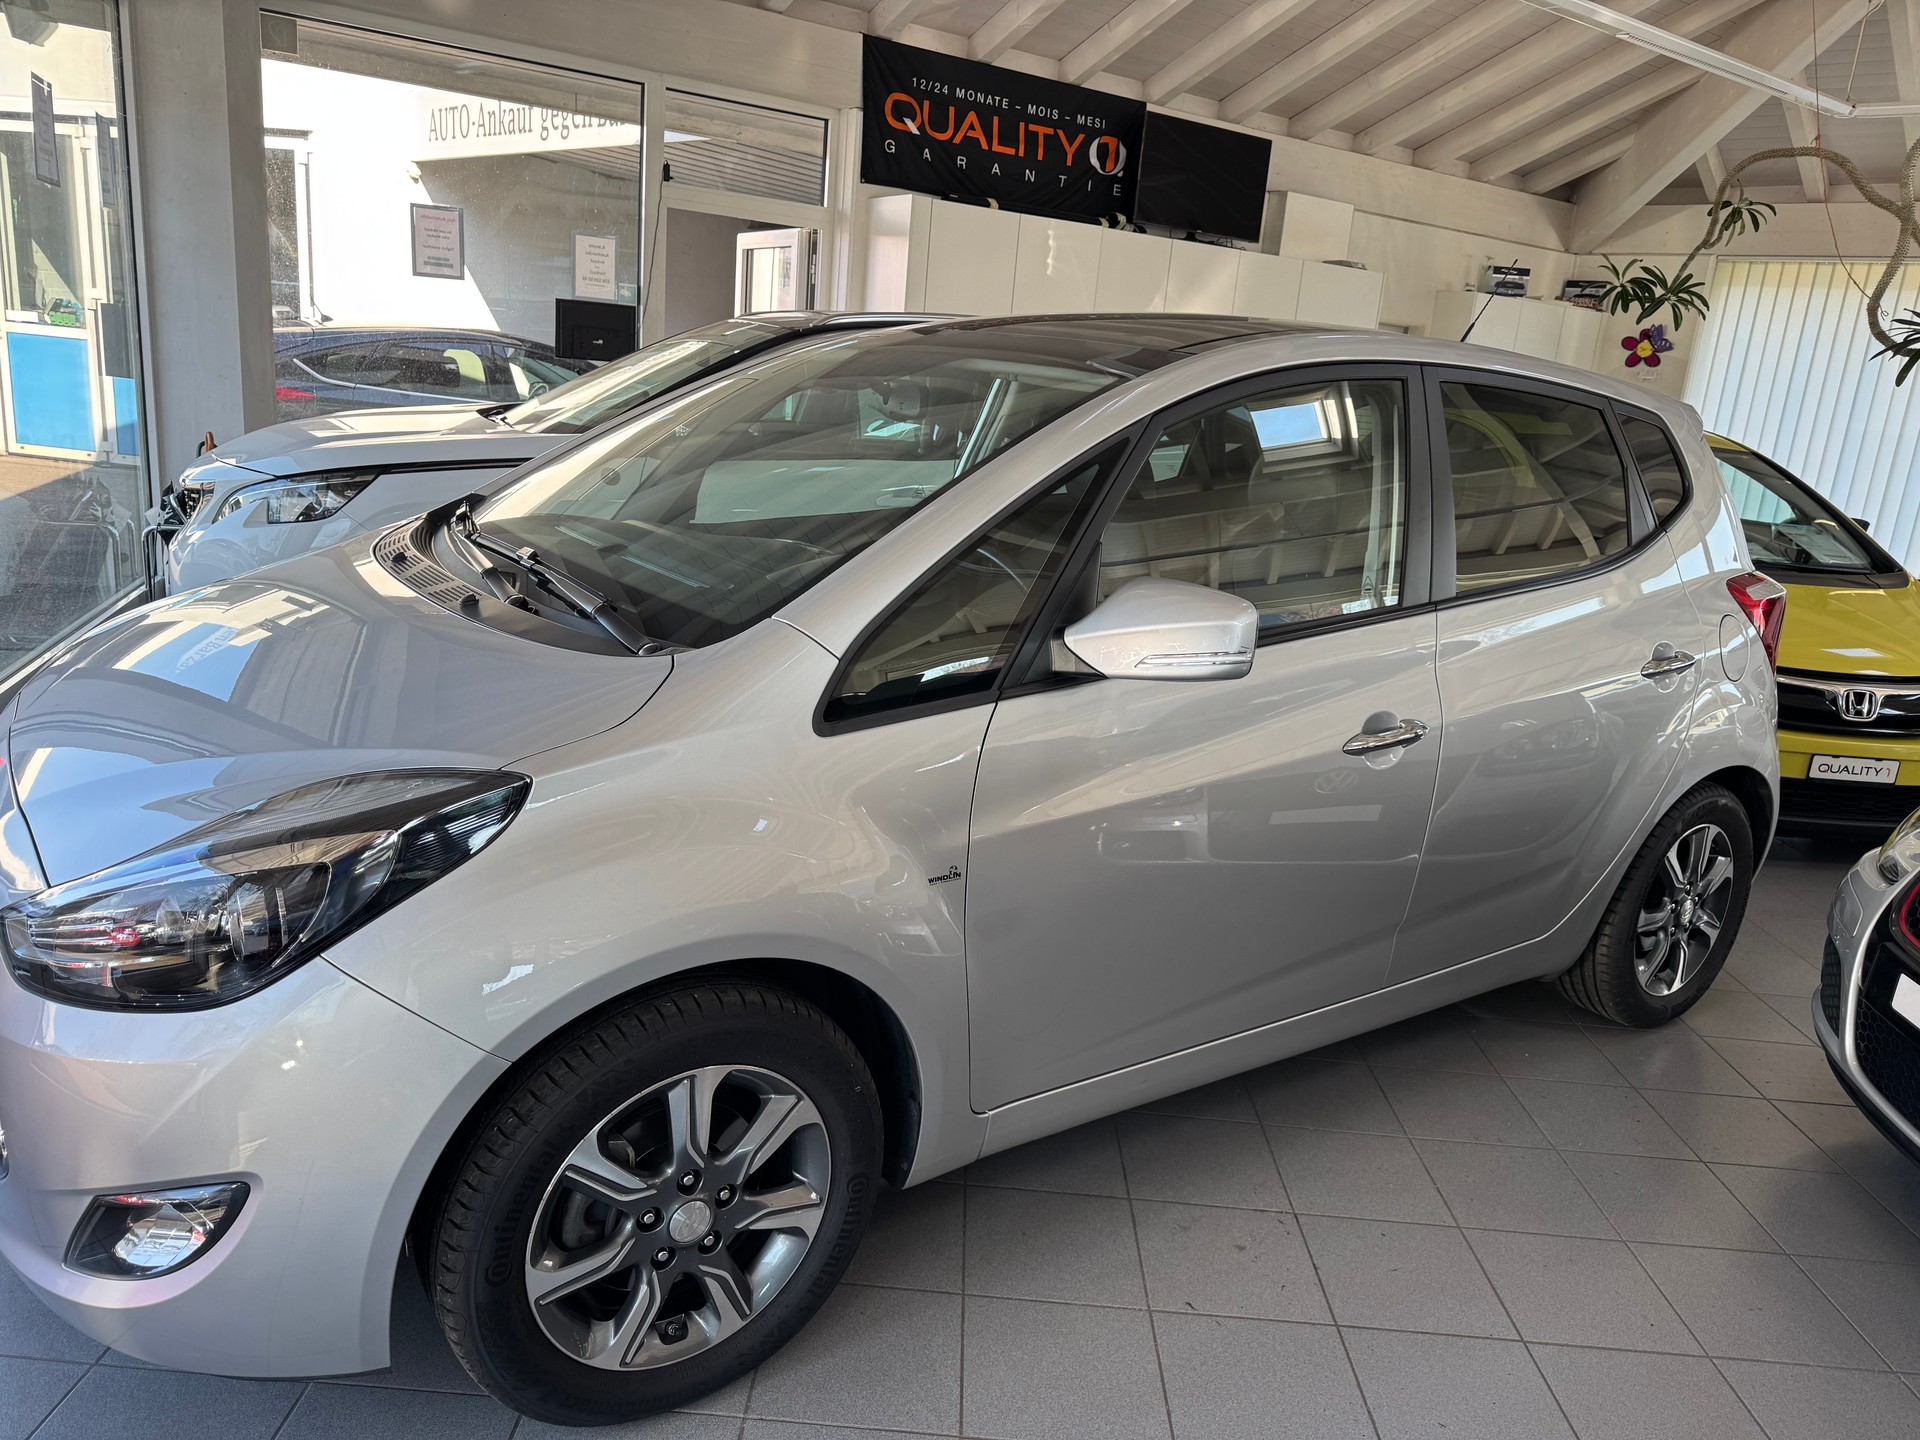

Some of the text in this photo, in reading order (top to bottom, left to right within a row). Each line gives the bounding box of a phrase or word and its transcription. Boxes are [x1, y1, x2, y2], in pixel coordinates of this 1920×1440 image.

[884, 92, 1086, 166] QUALITY
[912, 77, 949, 95] 12/24
[956, 87, 1010, 109] MONATE
[1027, 104, 1059, 120] MOIS
[1077, 114, 1106, 129] MESI
[884, 139, 1122, 196] GARANTIE
[1818, 763, 1883, 777] QUALITY
[485, 1141, 559, 1288] Continental
[808, 1172, 869, 1298] Continental
